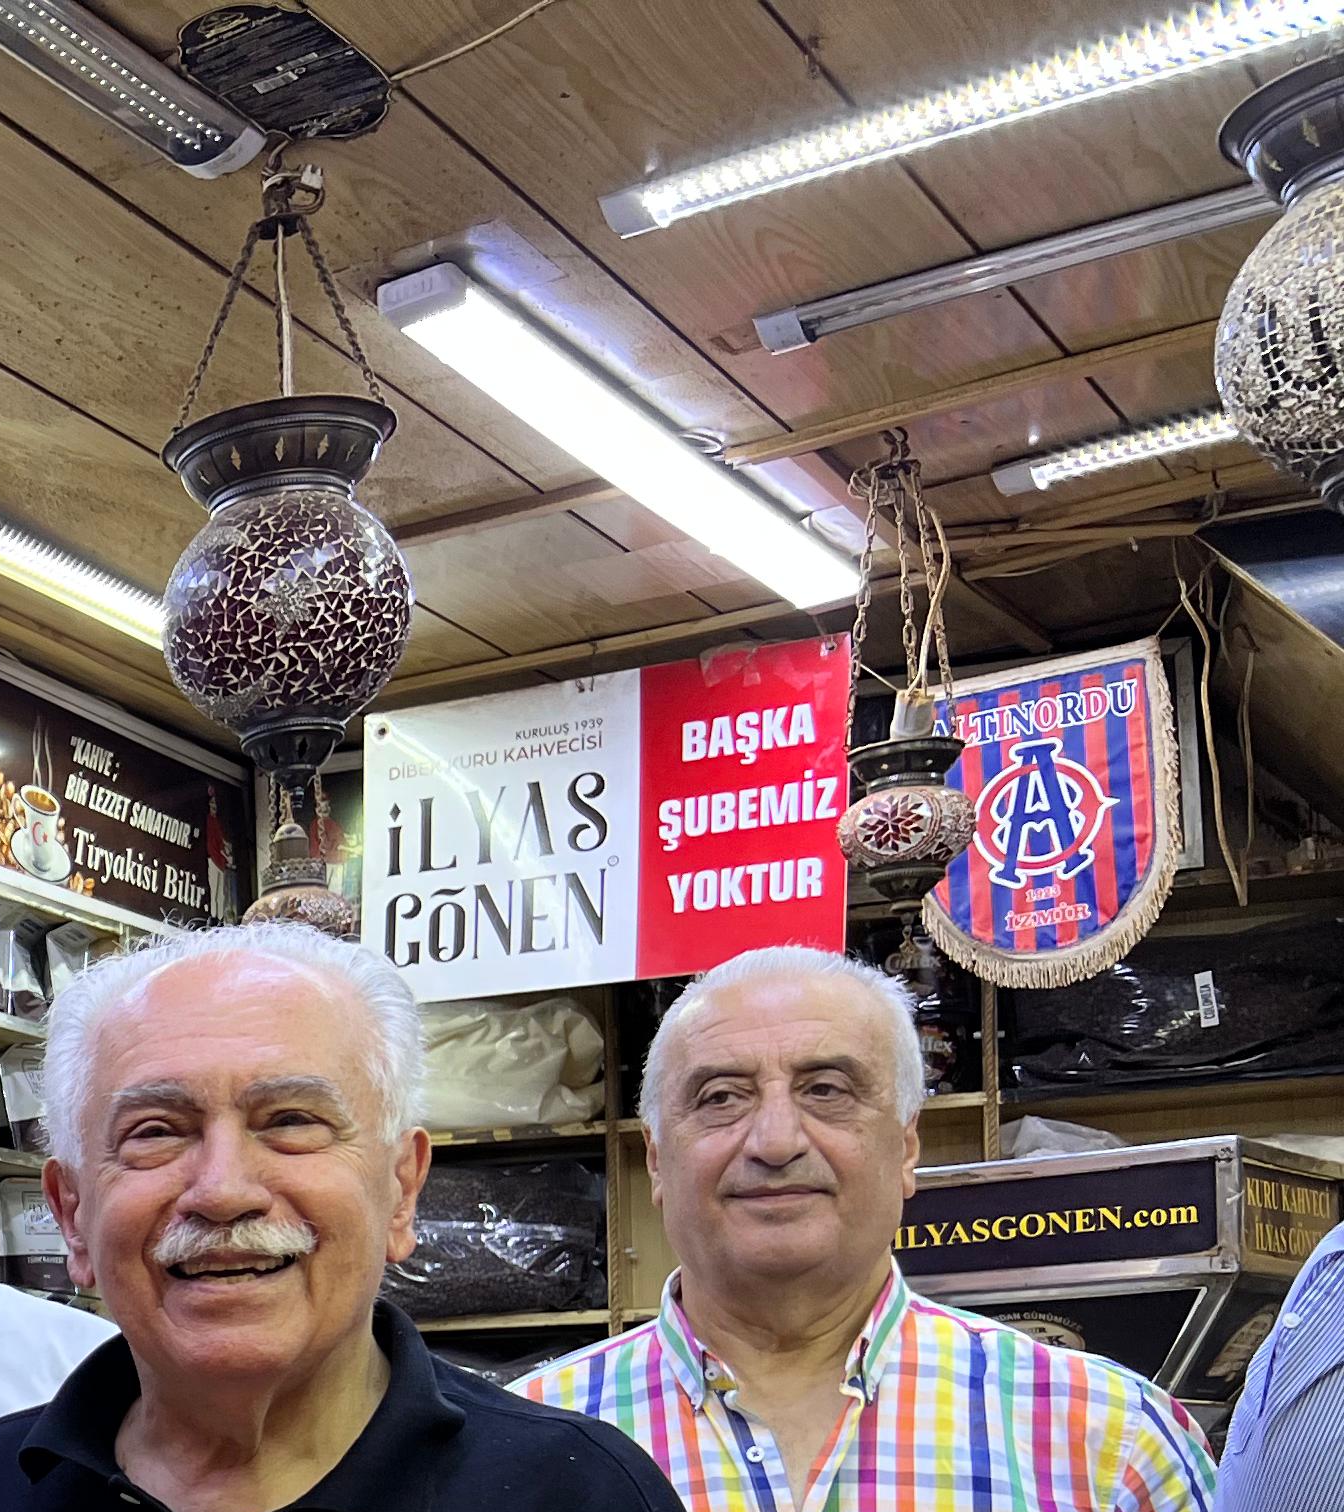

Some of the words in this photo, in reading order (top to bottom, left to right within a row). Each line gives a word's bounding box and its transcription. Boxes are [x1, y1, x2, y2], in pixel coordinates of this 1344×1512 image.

[447, 749, 497, 771] KURU
[504, 730, 603, 762] KAHVECİSİ
[515, 722, 570, 741] KURULUŞ
[574, 717, 604, 732] 1939
[680, 702, 816, 764] BAŞKA
[64, 771, 90, 806] BİR
[89, 783, 131, 822] LEZZET
[657, 773, 839, 849] ŞUBEMİZ
[387, 772, 608, 877] İLYAS
[73, 827, 159, 894] Tiryakisi
[667, 856, 824, 915] YOKTUR
[1246, 1177, 1279, 1210] KURU
[1281, 1183, 1330, 1219] KAHVECİ
[1255, 1215, 1287, 1254] İLYAS
